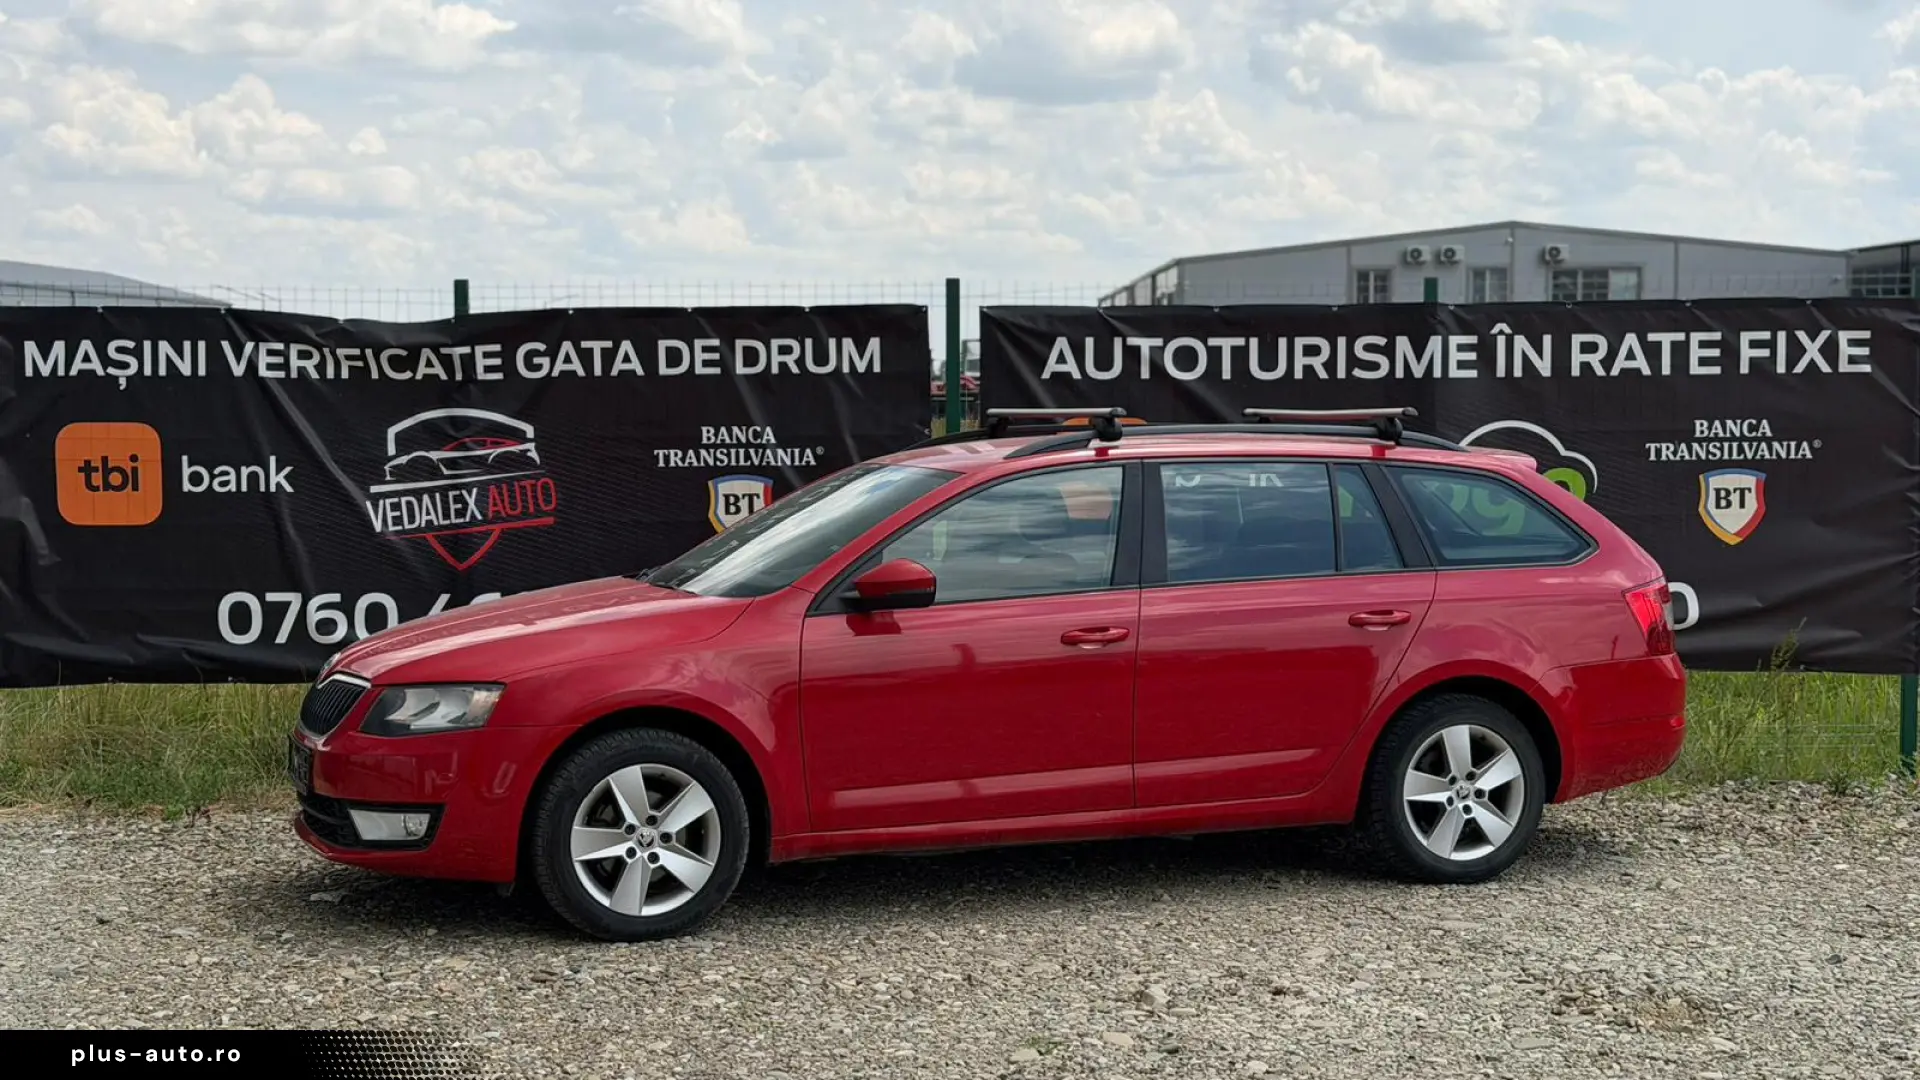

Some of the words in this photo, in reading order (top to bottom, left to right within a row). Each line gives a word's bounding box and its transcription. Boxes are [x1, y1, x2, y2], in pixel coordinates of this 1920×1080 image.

[24, 339, 207, 390] MAȘINI
[221, 340, 503, 381] VERIFICATE
[515, 340, 645, 378] GATA
[657, 338, 721, 376] DE
[735, 336, 882, 375] DRUM
[1041, 334, 1479, 380] AUTOTURISME
[1489, 322, 1552, 378] ÎN
[1571, 330, 1723, 377] RATE
[1739, 329, 1873, 375] FIXE
[701, 425, 777, 444] BANCA
[1693, 419, 1773, 438] BANCA
[77, 453, 140, 493] tbi
[181, 455, 295, 493] bank
[366, 487, 482, 533] VEDALEX
[487, 477, 558, 520] AUTO
[722, 493, 760, 515] BT
[1712, 487, 1752, 510] BT
